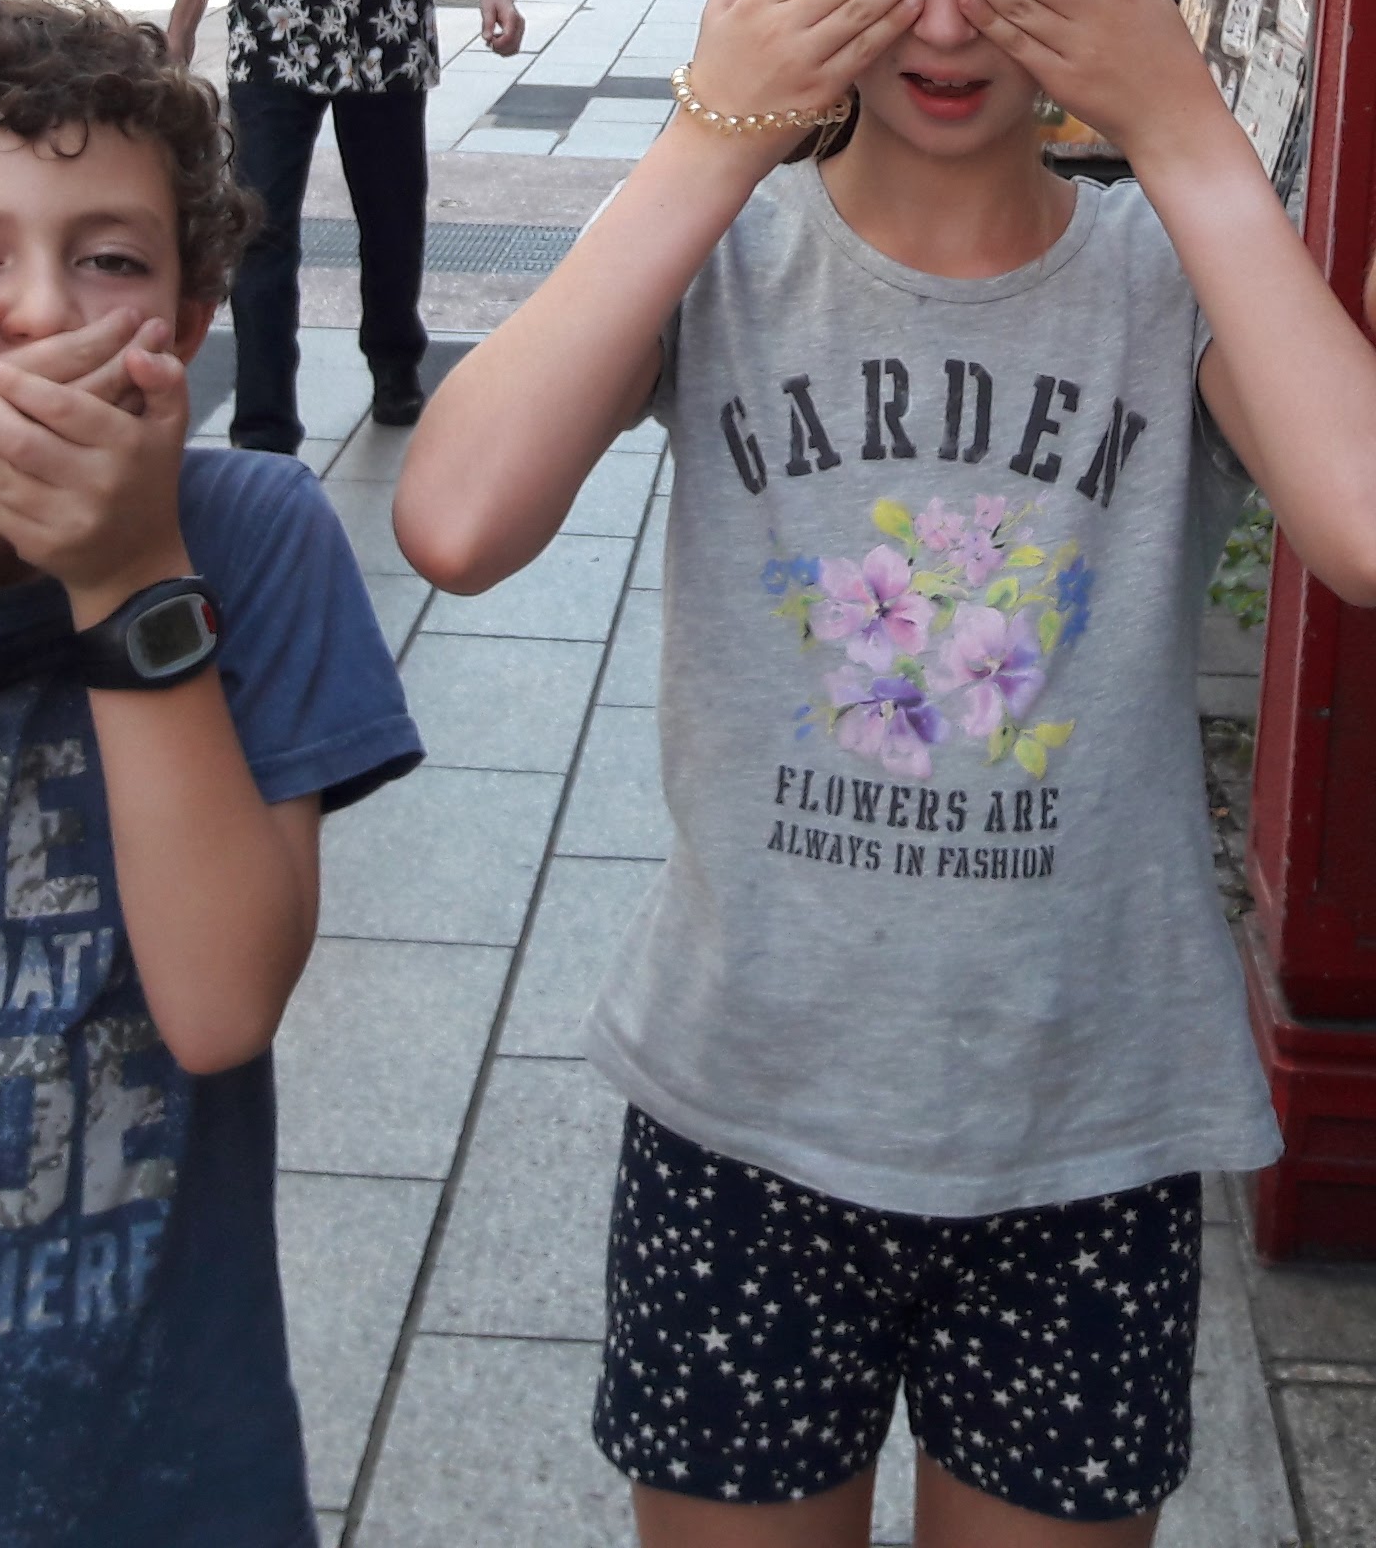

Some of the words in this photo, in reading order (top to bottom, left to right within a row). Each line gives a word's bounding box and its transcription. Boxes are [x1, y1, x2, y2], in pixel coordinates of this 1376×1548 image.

[719, 358, 1147, 508] GARDEN
[774, 764, 968, 833] FLOWERS
[983, 788, 1060, 833] ARE
[767, 818, 881, 872] ALWAYS
[894, 842, 924, 878] IN
[936, 844, 1055, 880] FASHION
